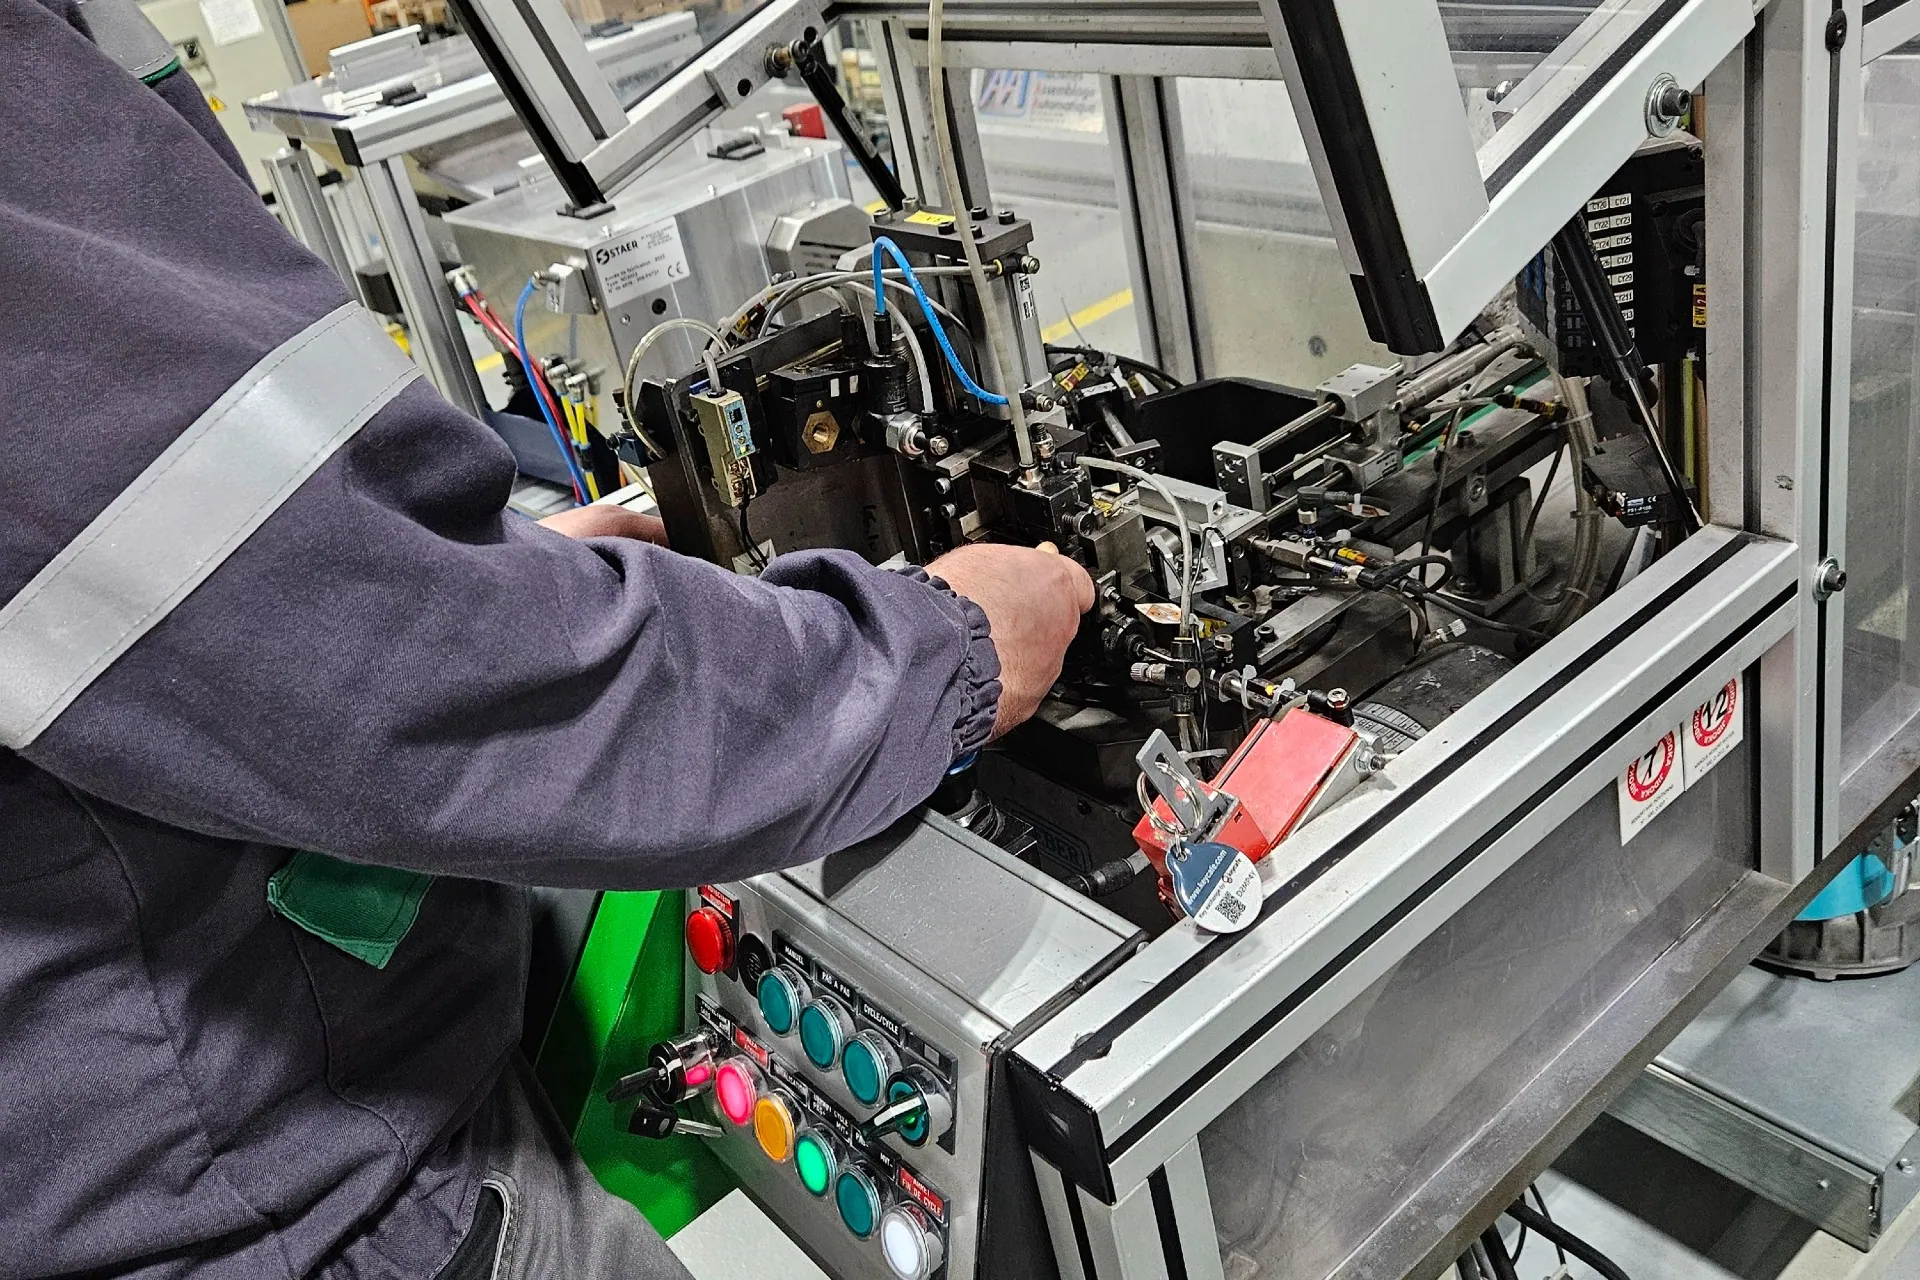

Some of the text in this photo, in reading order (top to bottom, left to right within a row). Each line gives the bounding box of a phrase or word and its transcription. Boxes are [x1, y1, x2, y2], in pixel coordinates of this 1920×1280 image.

[1614, 197, 1630, 206] CY21
[1594, 216, 1631, 230] CY22 CY23
[609, 239, 639, 259] STAER
[1616, 235, 1631, 245] CY25
[1616, 255, 1632, 265] CY27
[1640, 772, 1664, 799] JIDOKA
[1188, 849, 1228, 905] www.keycafe.com
[784, 945, 805, 966] MANUEL
[822, 971, 832, 985] PAS
[840, 984, 851, 998] PAS
[863, 1003, 899, 1035] CYCLE/CYCLE
[902, 1178, 912, 1193] FIN
[923, 1196, 941, 1216] CYCLE
